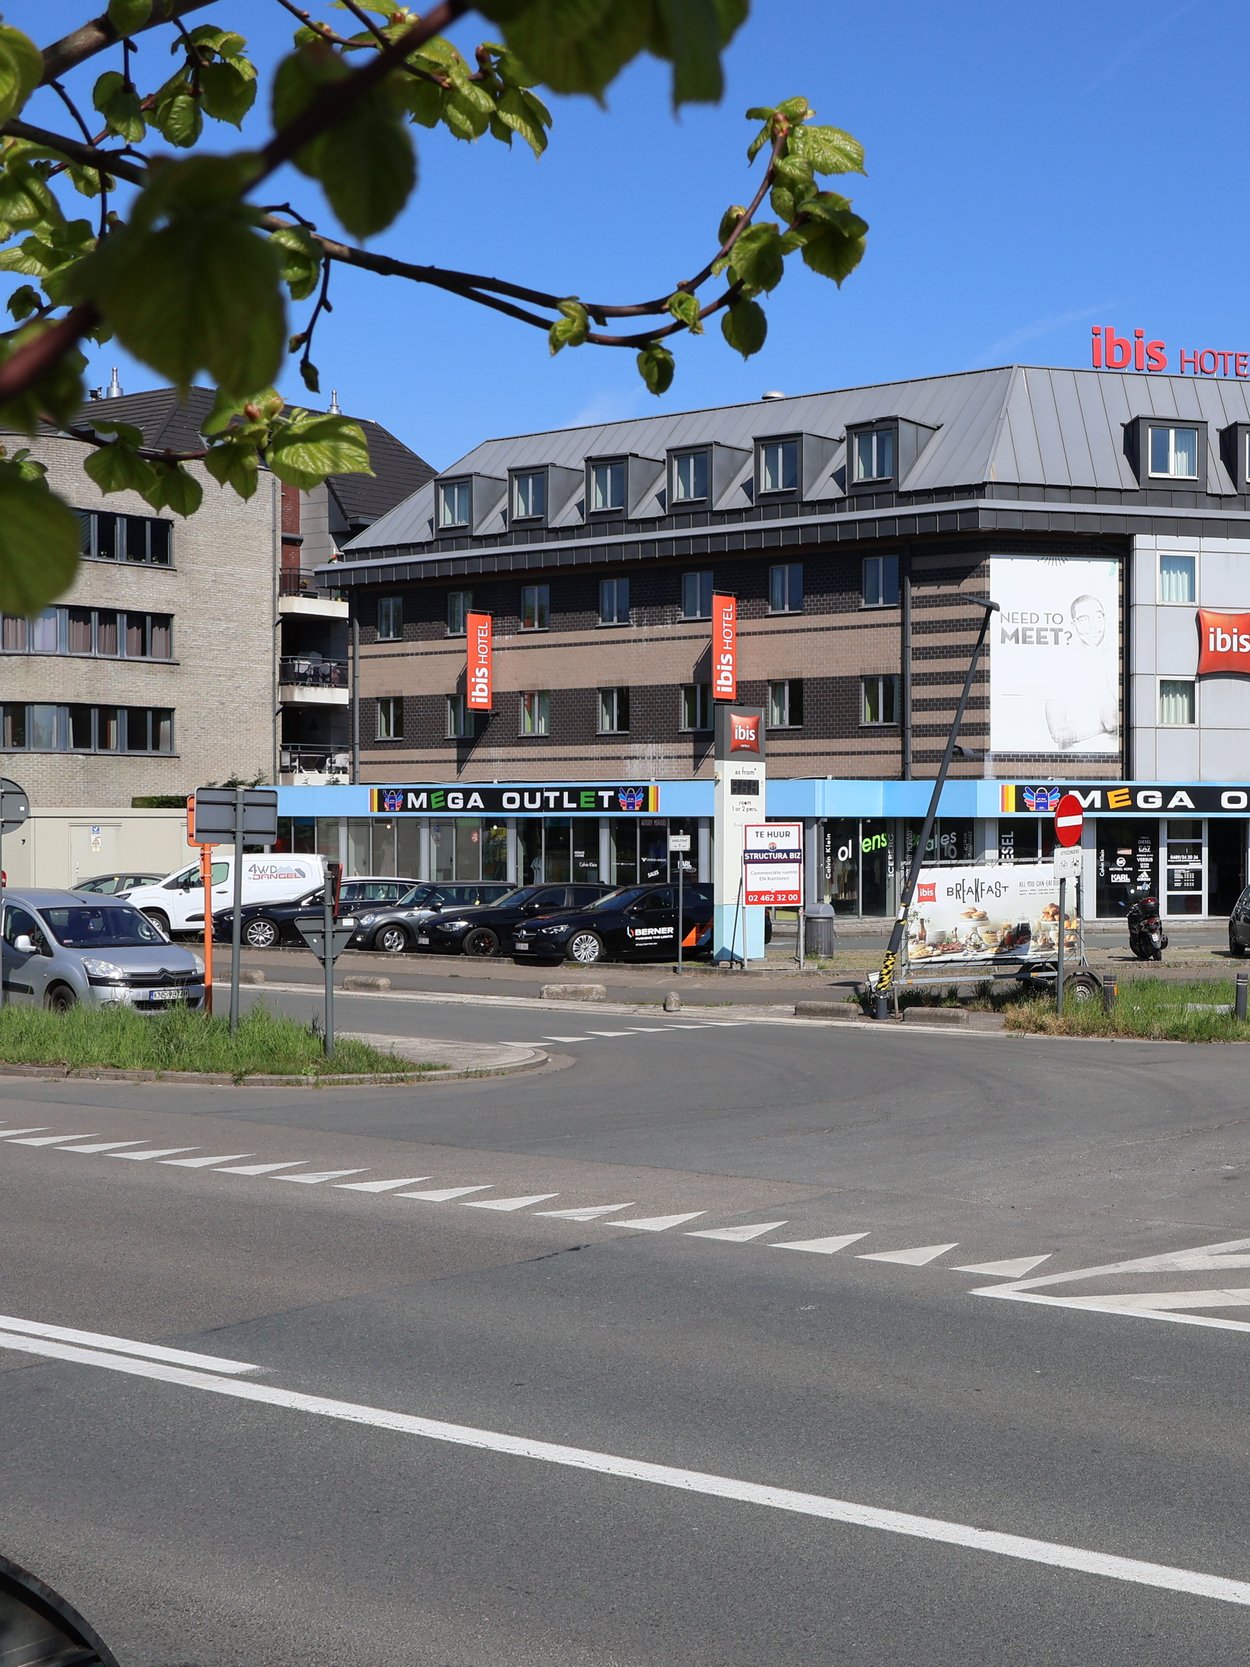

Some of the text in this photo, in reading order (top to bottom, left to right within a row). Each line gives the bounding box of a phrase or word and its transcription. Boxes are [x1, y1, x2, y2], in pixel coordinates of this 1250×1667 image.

[1092, 326, 1168, 371] ibis
[1000, 612, 1064, 625] NEED TO
[1000, 627, 1073, 645] MEET?
[1209, 627, 1250, 653] ibis
[717, 604, 733, 693] ibis HOTEL
[471, 621, 489, 703] ibis HOTEL
[734, 725, 756, 741] ibis
[407, 790, 614, 809] MEGA OUTLET
[1069, 787, 1195, 809] MEGA
[1001, 831, 1014, 860] ESEL
[248, 863, 278, 874] 4WD
[919, 889, 934, 897] ibis
[946, 878, 1009, 903] BREAKFAST
[634, 926, 675, 936] BERNER
